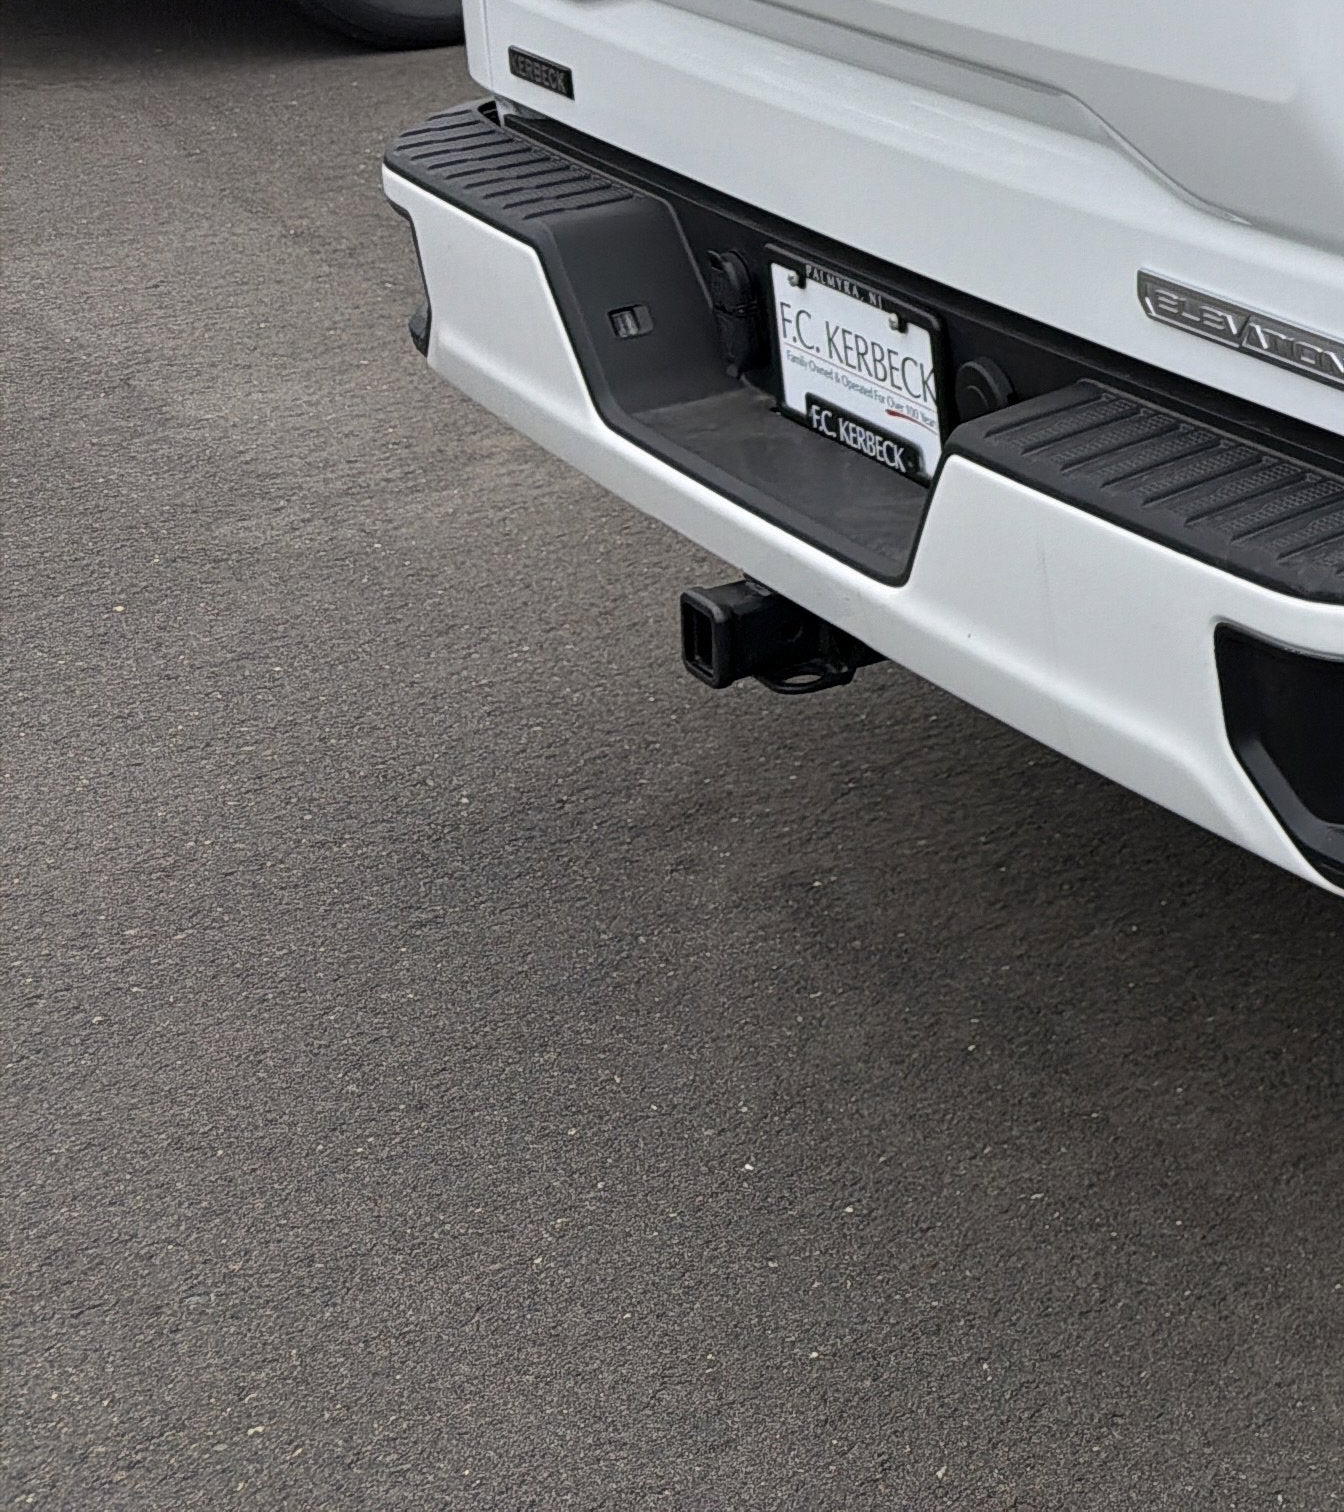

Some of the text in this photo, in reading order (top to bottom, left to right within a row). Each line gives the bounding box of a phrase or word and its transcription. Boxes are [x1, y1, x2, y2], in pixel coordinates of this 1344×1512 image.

[805, 264, 883, 310] PALMYRA, NJ
[779, 301, 938, 404] F.C. KERBECK
[838, 417, 907, 473] KERBECK
